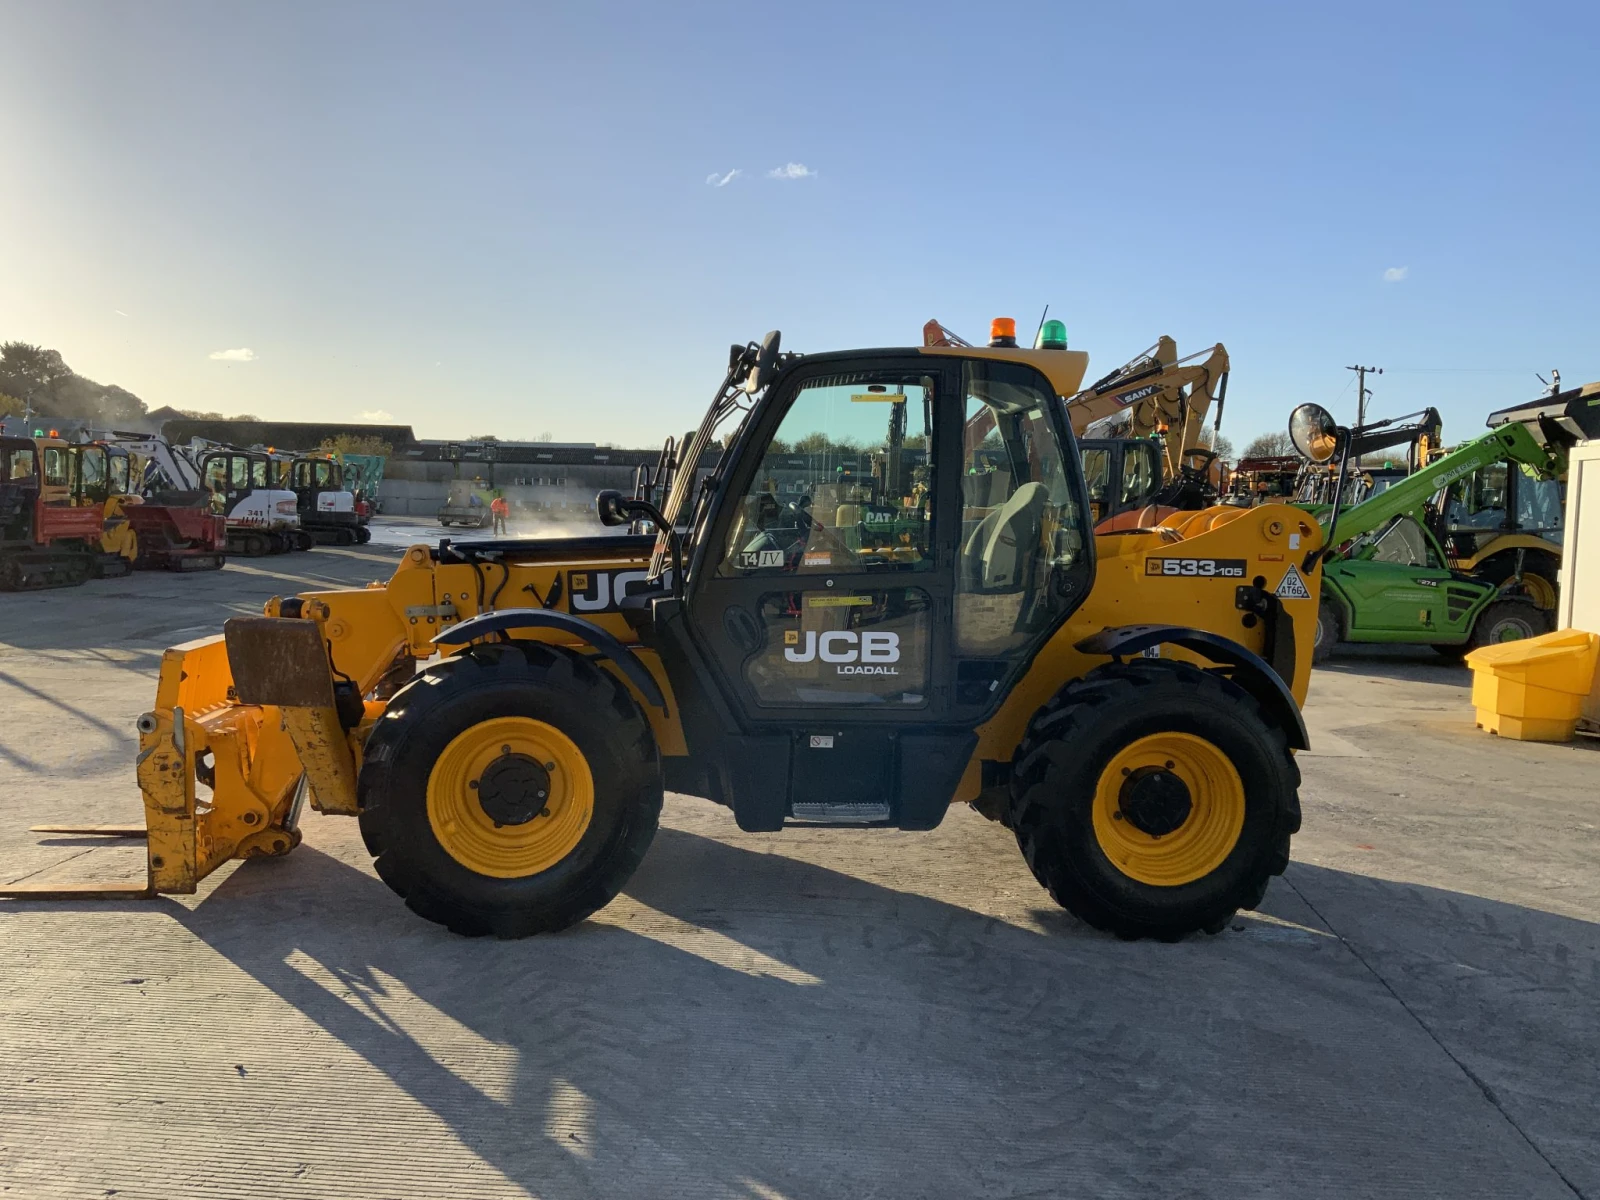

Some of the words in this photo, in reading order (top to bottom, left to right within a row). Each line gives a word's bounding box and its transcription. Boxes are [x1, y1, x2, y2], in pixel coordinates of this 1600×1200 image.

[1125, 387, 1152, 403] SANY
[1446, 457, 1480, 478] MERLO
[865, 511, 892, 523] CAT
[741, 553, 758, 566] T4
[762, 552, 781, 565] IV
[573, 571, 684, 610] JC
[1281, 586, 1303, 595] AT6G
[784, 630, 900, 663] JCB
[837, 665, 899, 675] LOADALL
